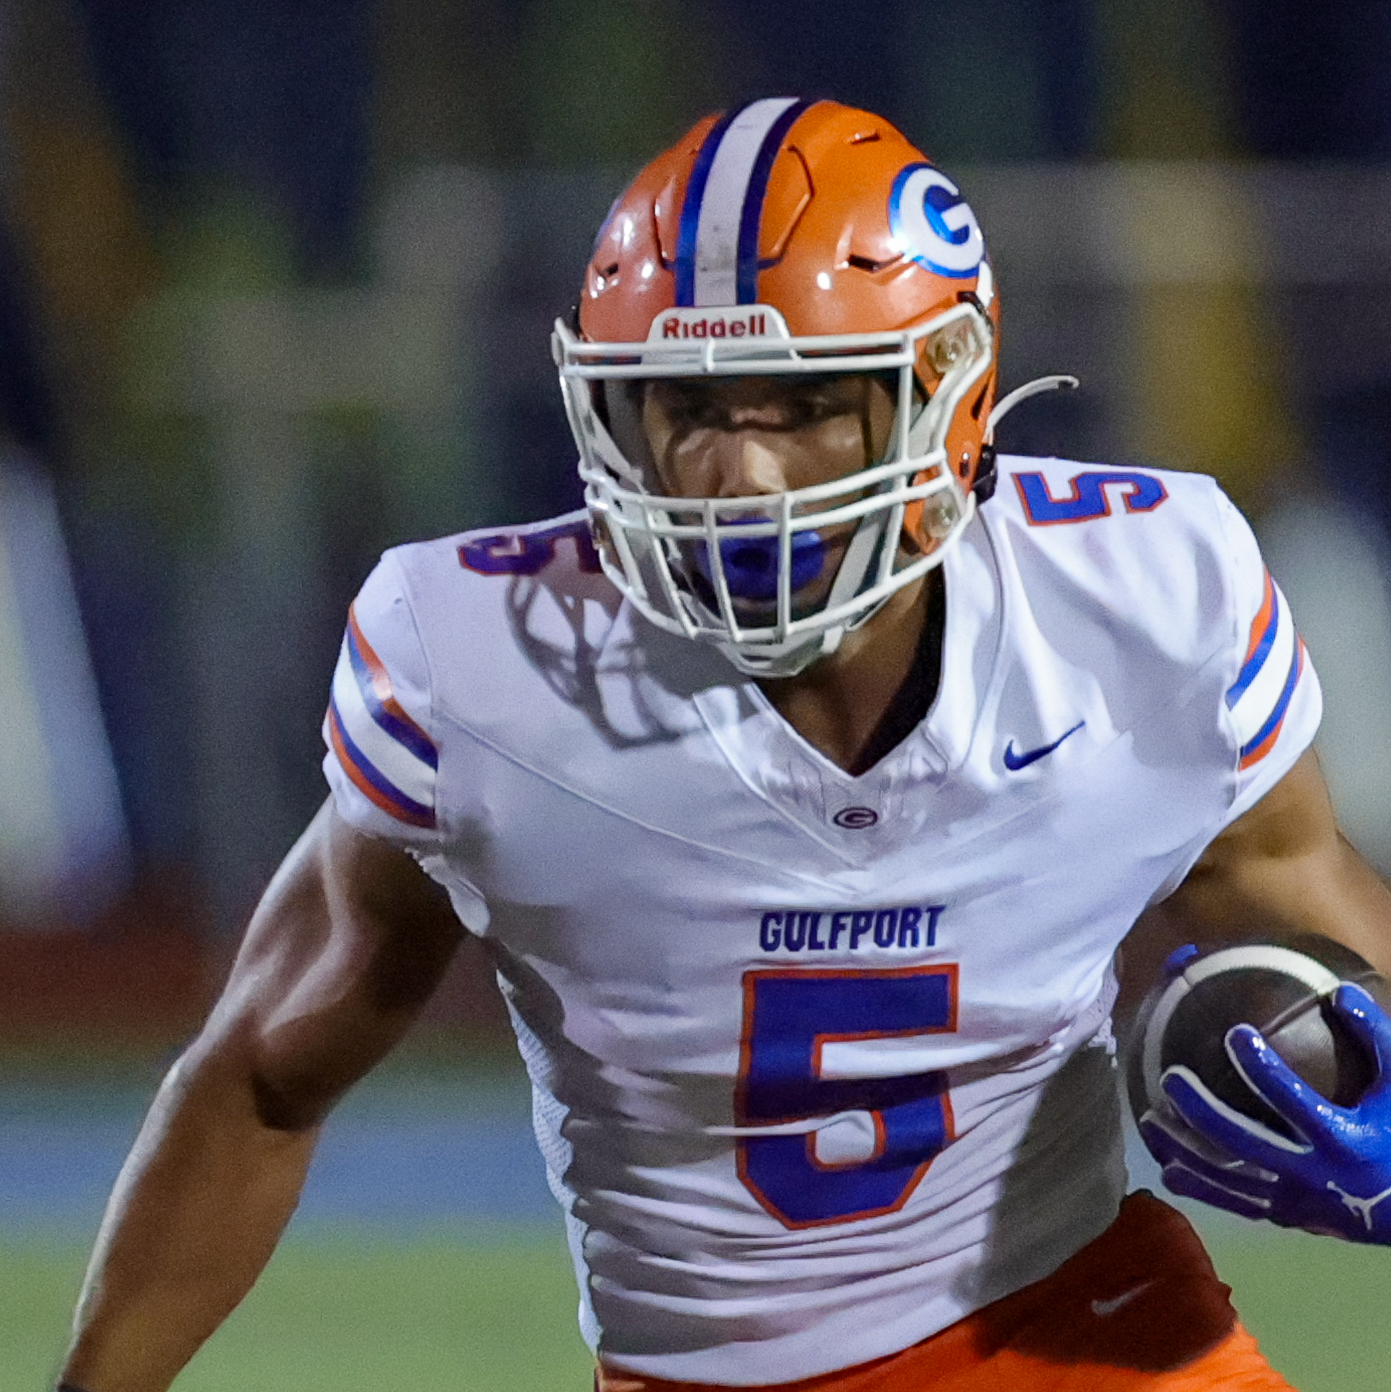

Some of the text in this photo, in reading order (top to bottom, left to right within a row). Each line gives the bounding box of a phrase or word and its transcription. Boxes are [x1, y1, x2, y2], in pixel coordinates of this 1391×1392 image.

[896, 166, 986, 273] G
[663, 313, 765, 338] Riddell
[1010, 471, 1169, 526] 5
[457, 519, 604, 576] 5
[759, 904, 946, 952] GULFPORT
[733, 963, 959, 1231] 5
